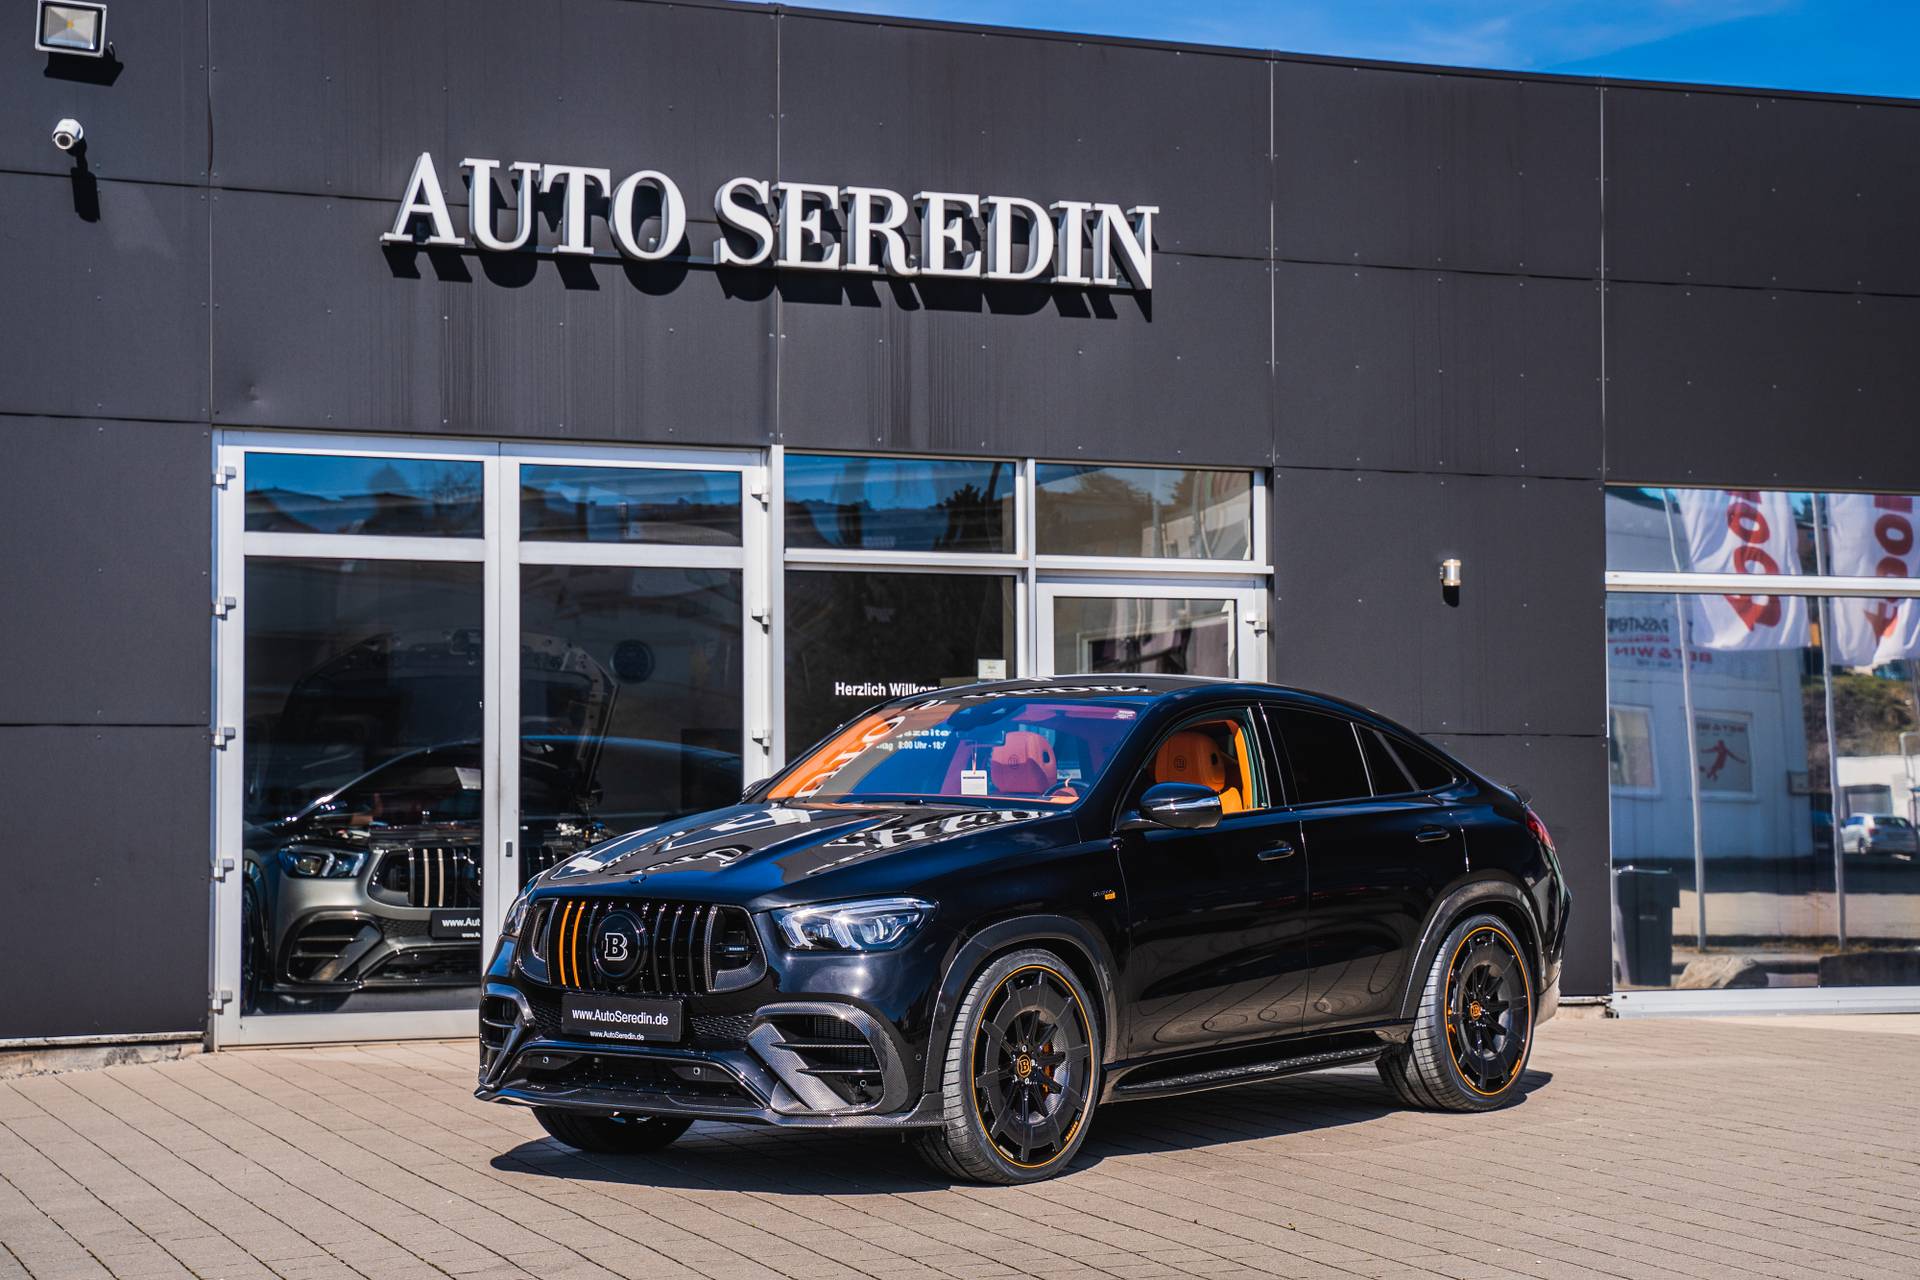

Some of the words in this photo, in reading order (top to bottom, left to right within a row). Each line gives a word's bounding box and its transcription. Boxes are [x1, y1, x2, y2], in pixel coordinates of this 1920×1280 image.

[379, 152, 688, 262] AUTO
[713, 177, 1160, 290] SEREDIN
[834, 682, 887, 697] Herzlich
[914, 740, 928, 750] Uhr
[441, 917, 481, 927] www.Aut
[604, 932, 628, 961] B
[571, 1008, 669, 1026] www.AutoSeredin.de
[589, 1030, 645, 1041] www.AutoSeredin.de
